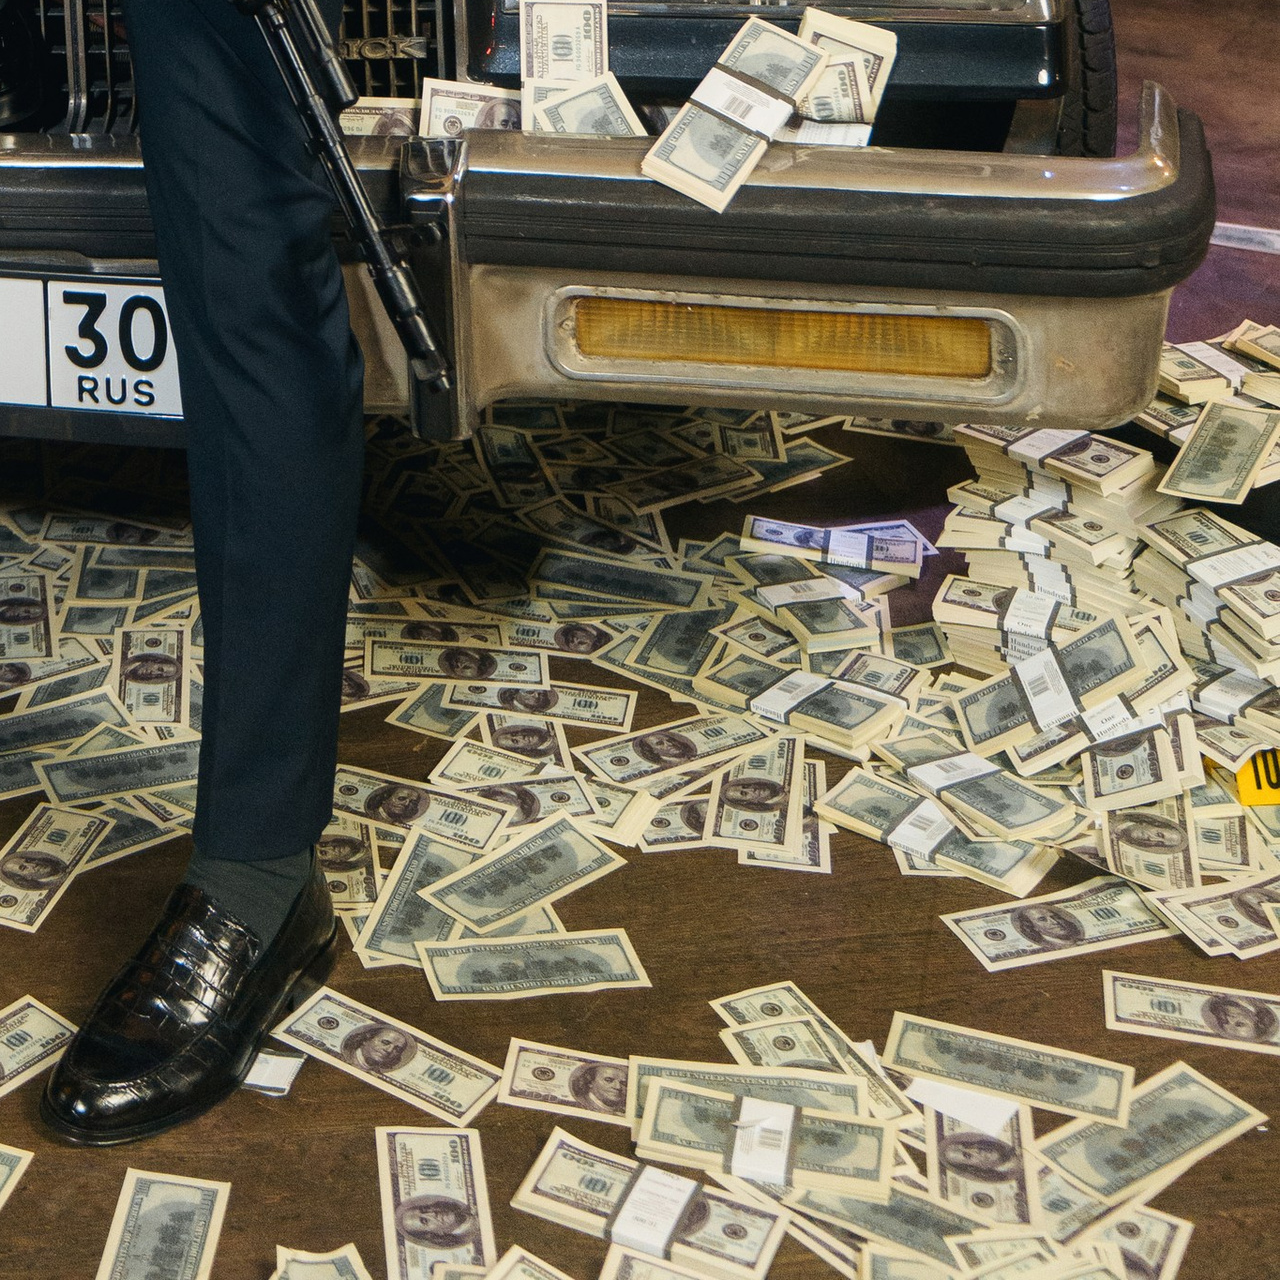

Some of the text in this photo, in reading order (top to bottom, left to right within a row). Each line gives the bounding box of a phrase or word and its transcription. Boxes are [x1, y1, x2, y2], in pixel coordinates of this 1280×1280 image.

[583, 10, 592, 40] 100
[838, 70, 850, 98] 100
[63, 290, 168, 373] 30
[78, 375, 157, 408] RUS
[1036, 585, 1069, 601] Hundreds
[893, 668, 909, 682] 100
[1096, 717, 1129, 738] Hundreds
[1100, 714, 1115, 725] One
[777, 742, 785, 759] 100
[77, 819, 98, 838] 100
[451, 832, 480, 843] 100
[501, 979, 552, 989] HUNDRED
[549, 975, 598, 985] DOLLARS
[38, 1030, 67, 1049] 100
[431, 1090, 463, 1109] 100
[448, 1139, 460, 1163] 100
